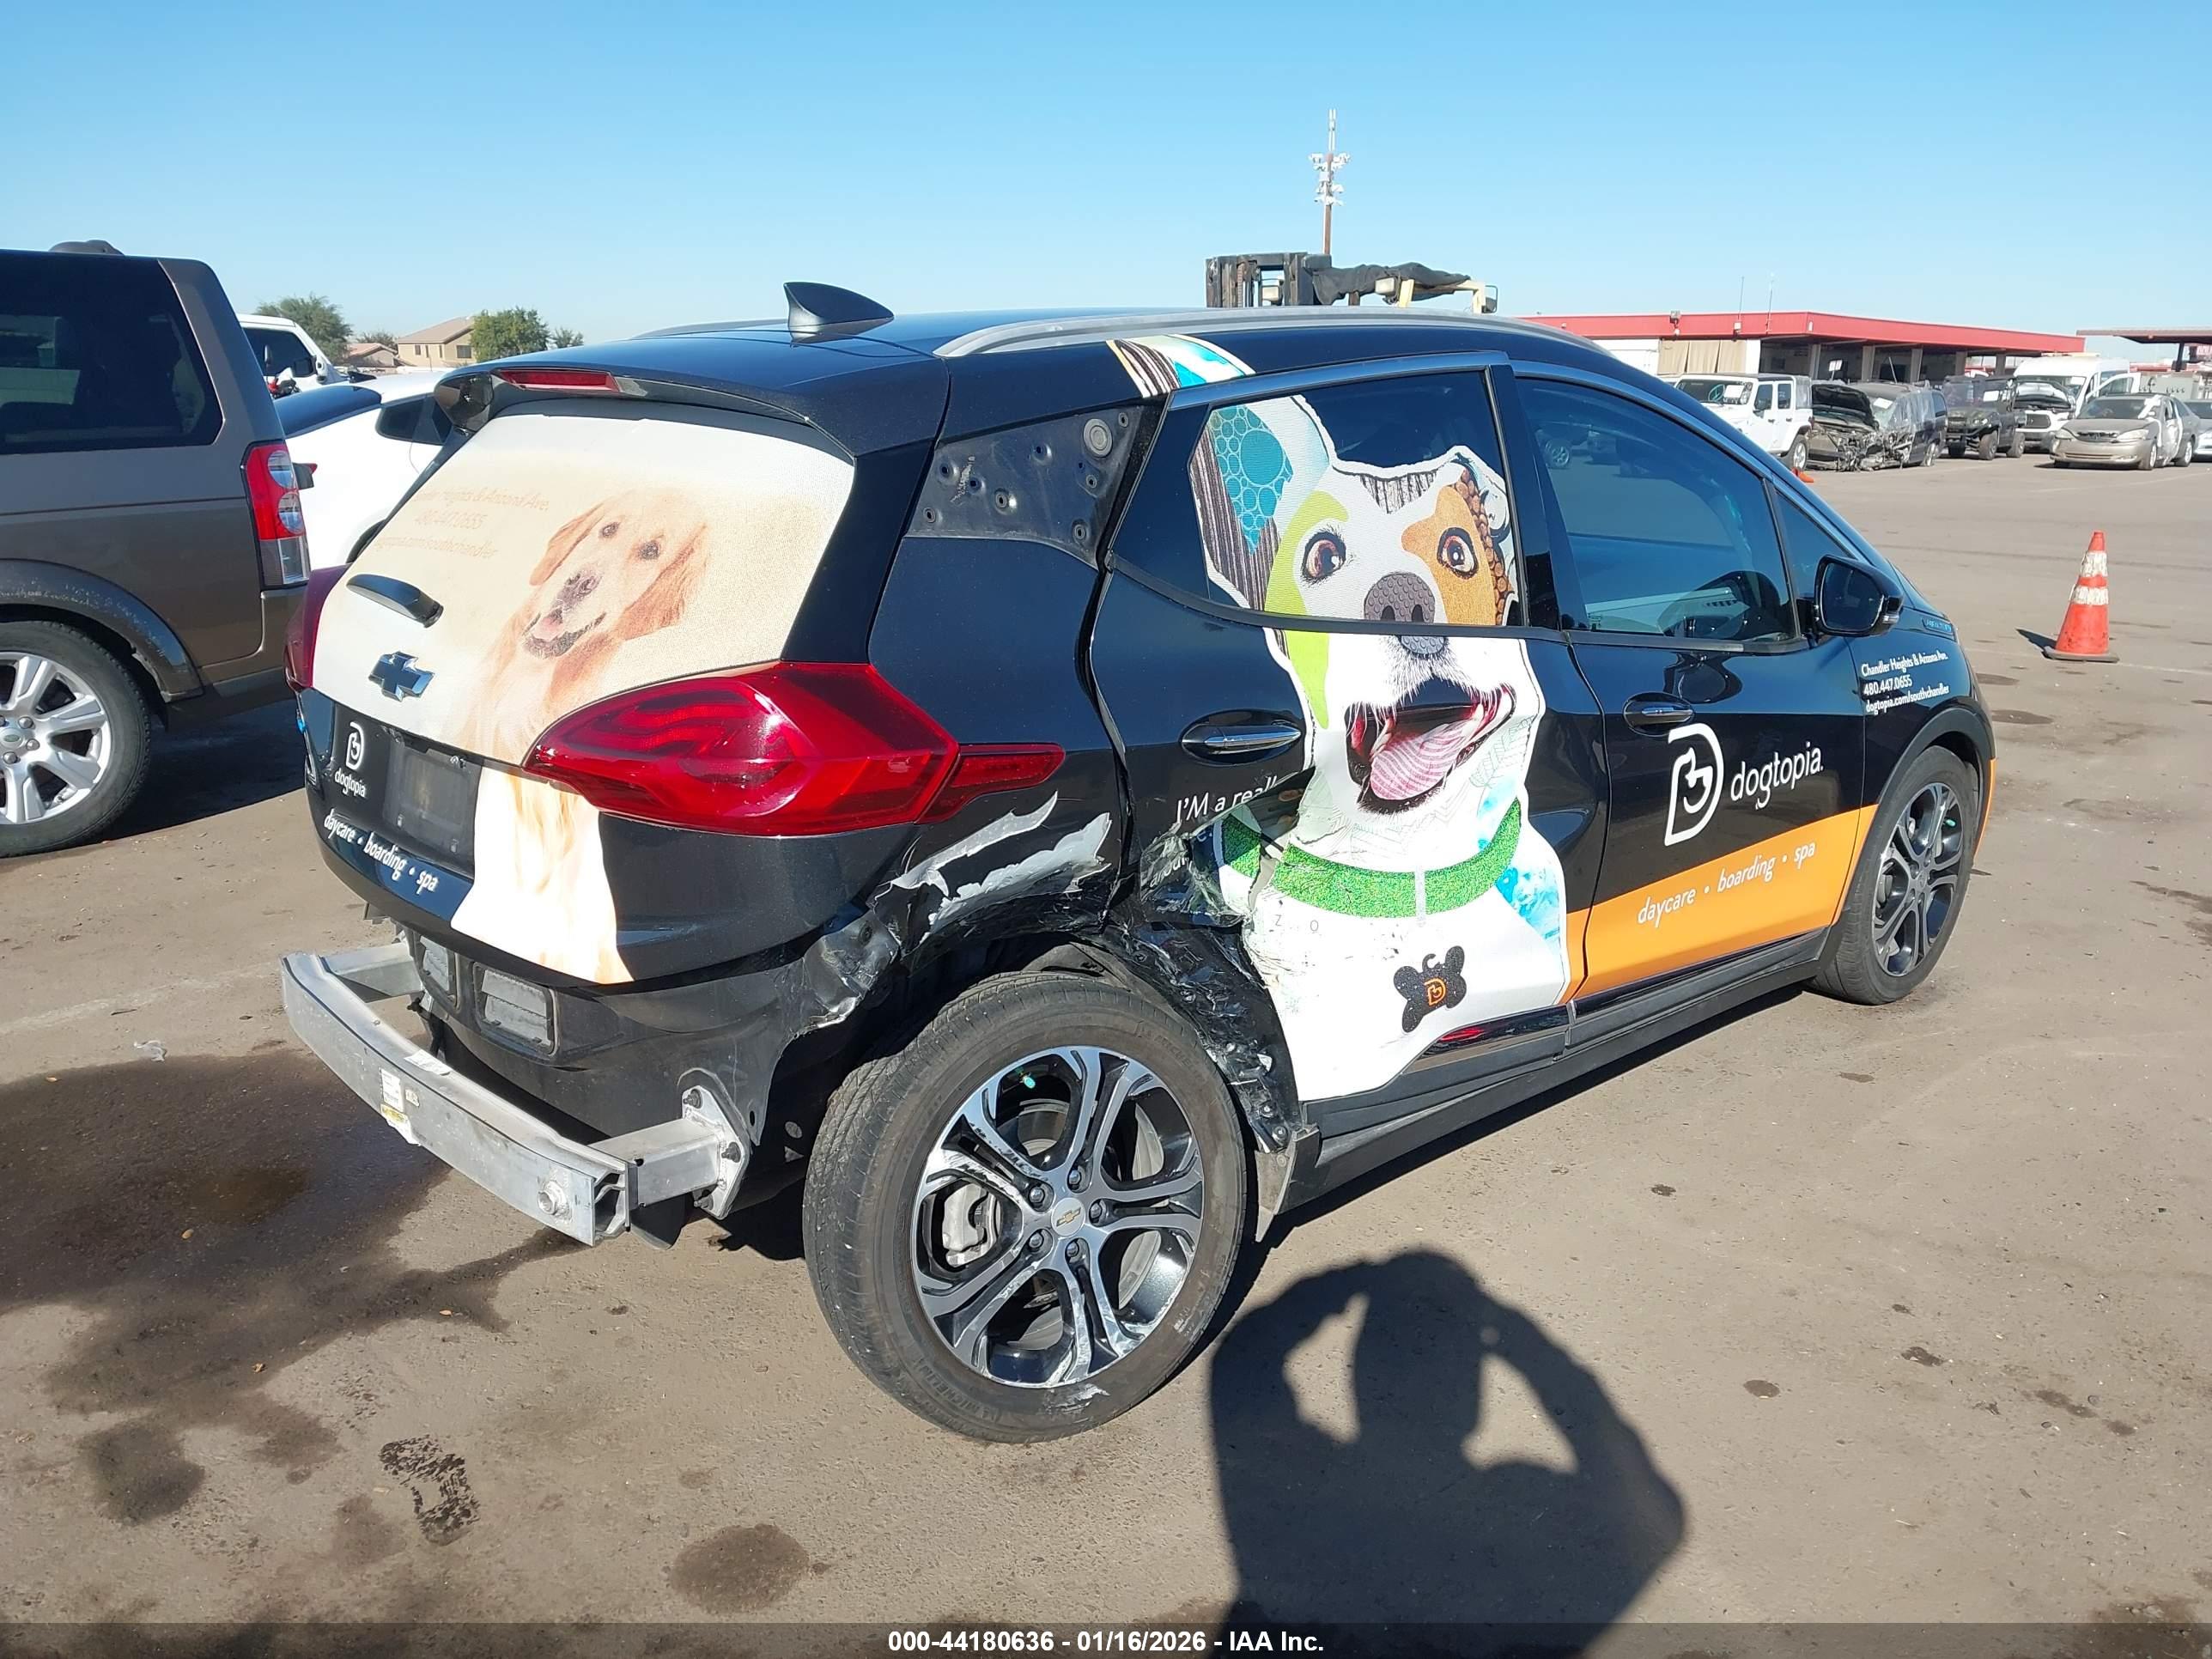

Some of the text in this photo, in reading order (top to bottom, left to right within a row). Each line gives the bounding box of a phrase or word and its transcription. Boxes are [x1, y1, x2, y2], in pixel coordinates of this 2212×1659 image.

[1861, 659, 1889, 677] Chandler
[1889, 655, 1913, 673] Heights
[1912, 653, 1919, 666] &
[1919, 652, 1937, 665] Arizona
[1863, 674, 1913, 696] 480.447.0655
[1865, 683, 1949, 715] dogtopia.com/southchandler
[1214, 796, 1226, 812] a
[324, 808, 356, 844] daycare
[363, 831, 408, 881] boarding
[416, 870, 440, 895] spa
[1638, 885, 1697, 928] daycare
[1717, 854, 1777, 893] boarding
[1793, 842, 1816, 870] spa
